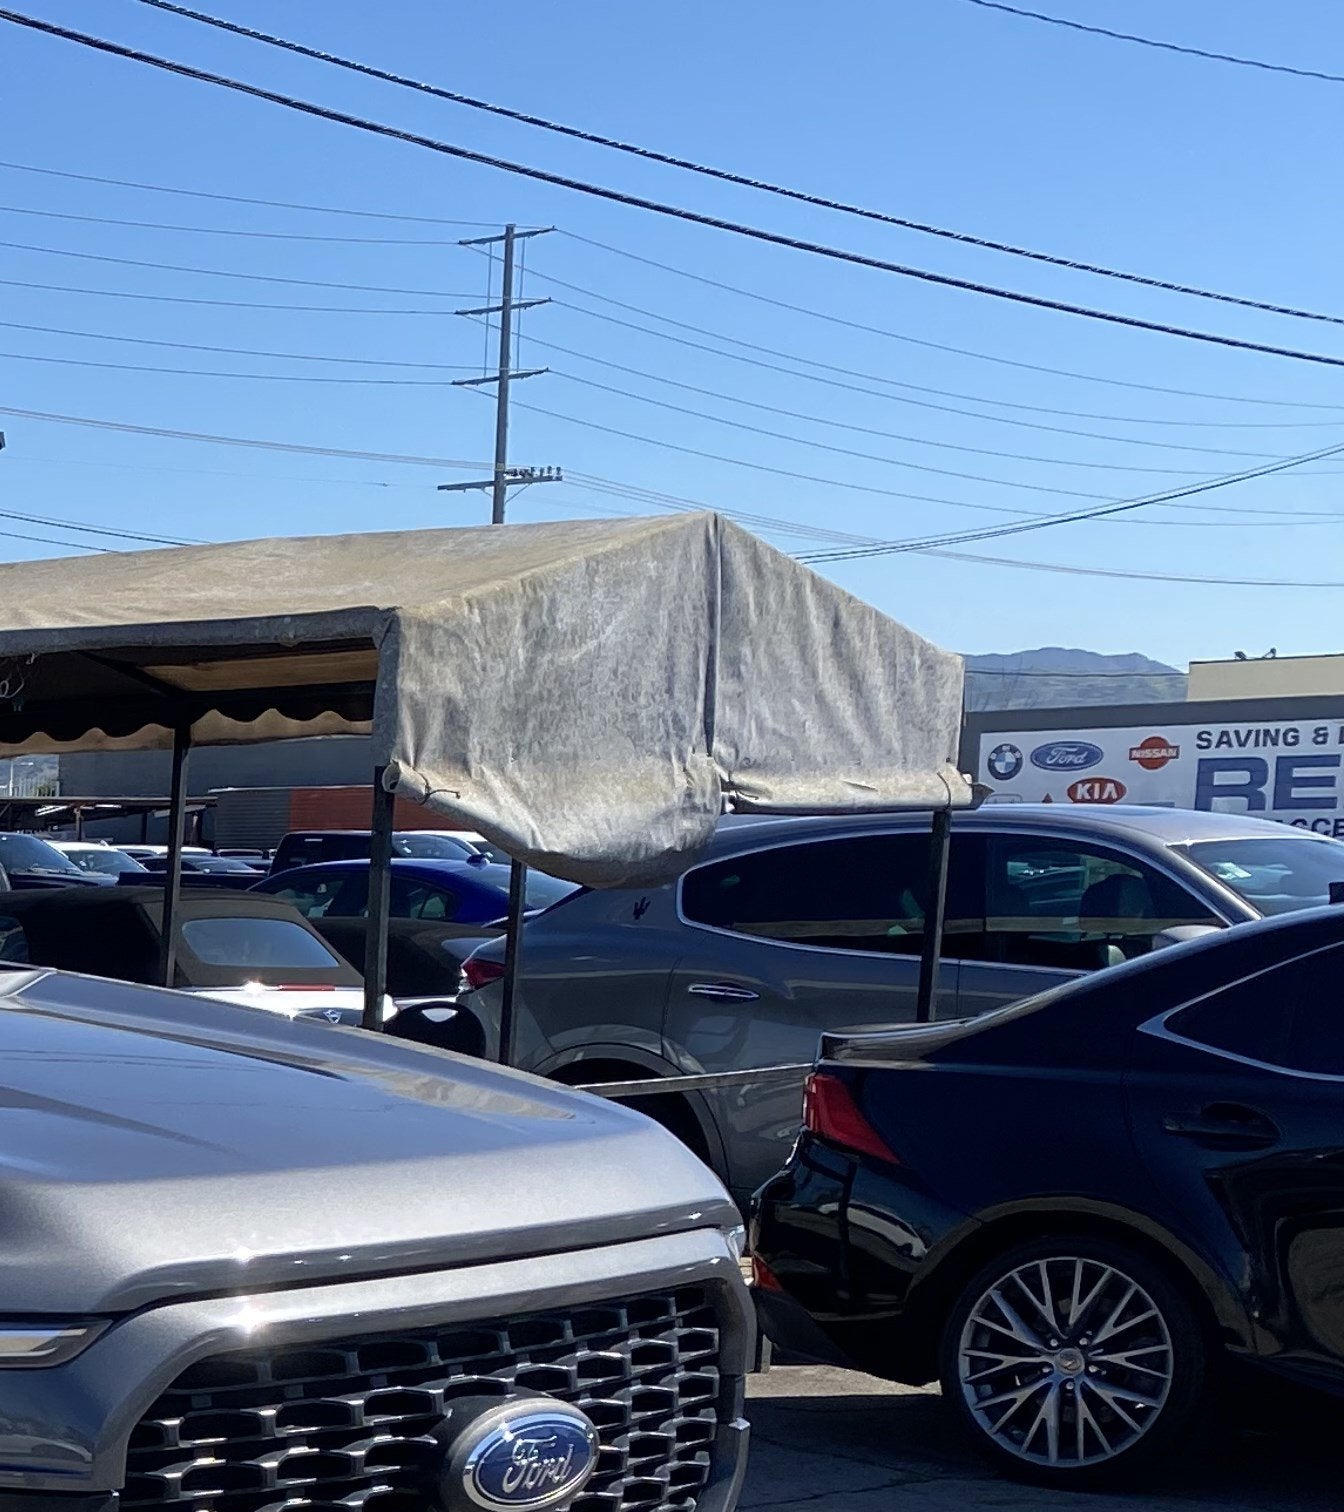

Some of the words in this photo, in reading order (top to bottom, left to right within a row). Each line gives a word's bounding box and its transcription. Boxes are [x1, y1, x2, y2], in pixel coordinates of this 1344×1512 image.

[1195, 727, 1300, 750] SAVING
[1312, 726, 1329, 745] &
[1045, 746, 1088, 765] Ford
[1131, 748, 1178, 759] NISSAN
[1077, 782, 1118, 800] KIA
[502, 1435, 574, 1494] Ford
